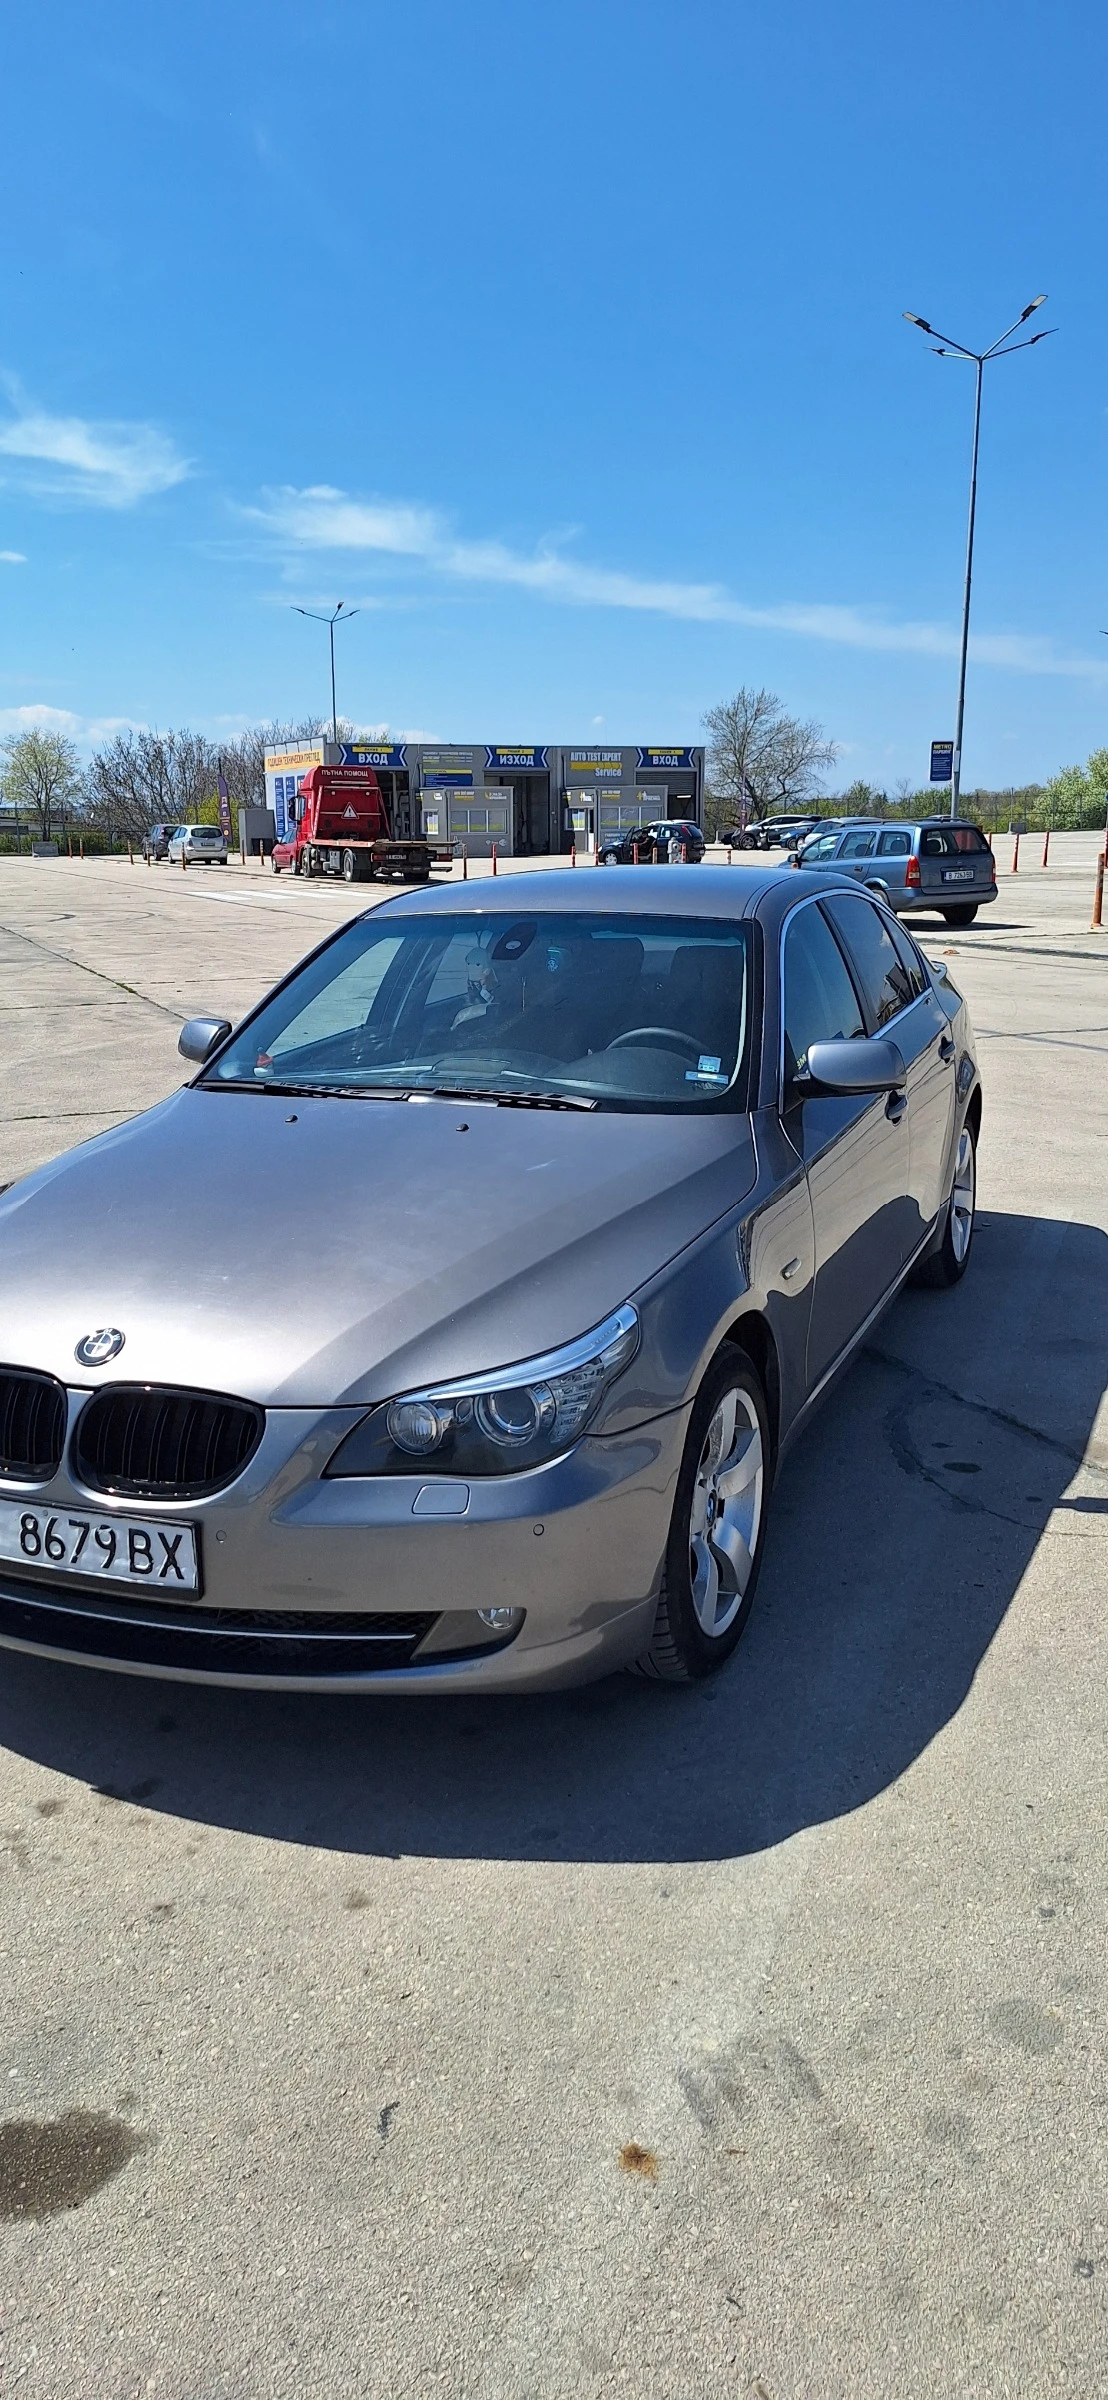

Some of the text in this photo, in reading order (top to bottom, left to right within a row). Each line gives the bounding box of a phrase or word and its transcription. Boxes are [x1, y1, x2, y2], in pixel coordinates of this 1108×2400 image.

[358, 753, 389, 765] ВХОД
[499, 755, 535, 766] ИЗХОД
[570, 752, 586, 762] AUTO
[587, 752, 601, 762] TEST
[652, 755, 679, 766] ВХОД
[595, 767, 622, 777] Service
